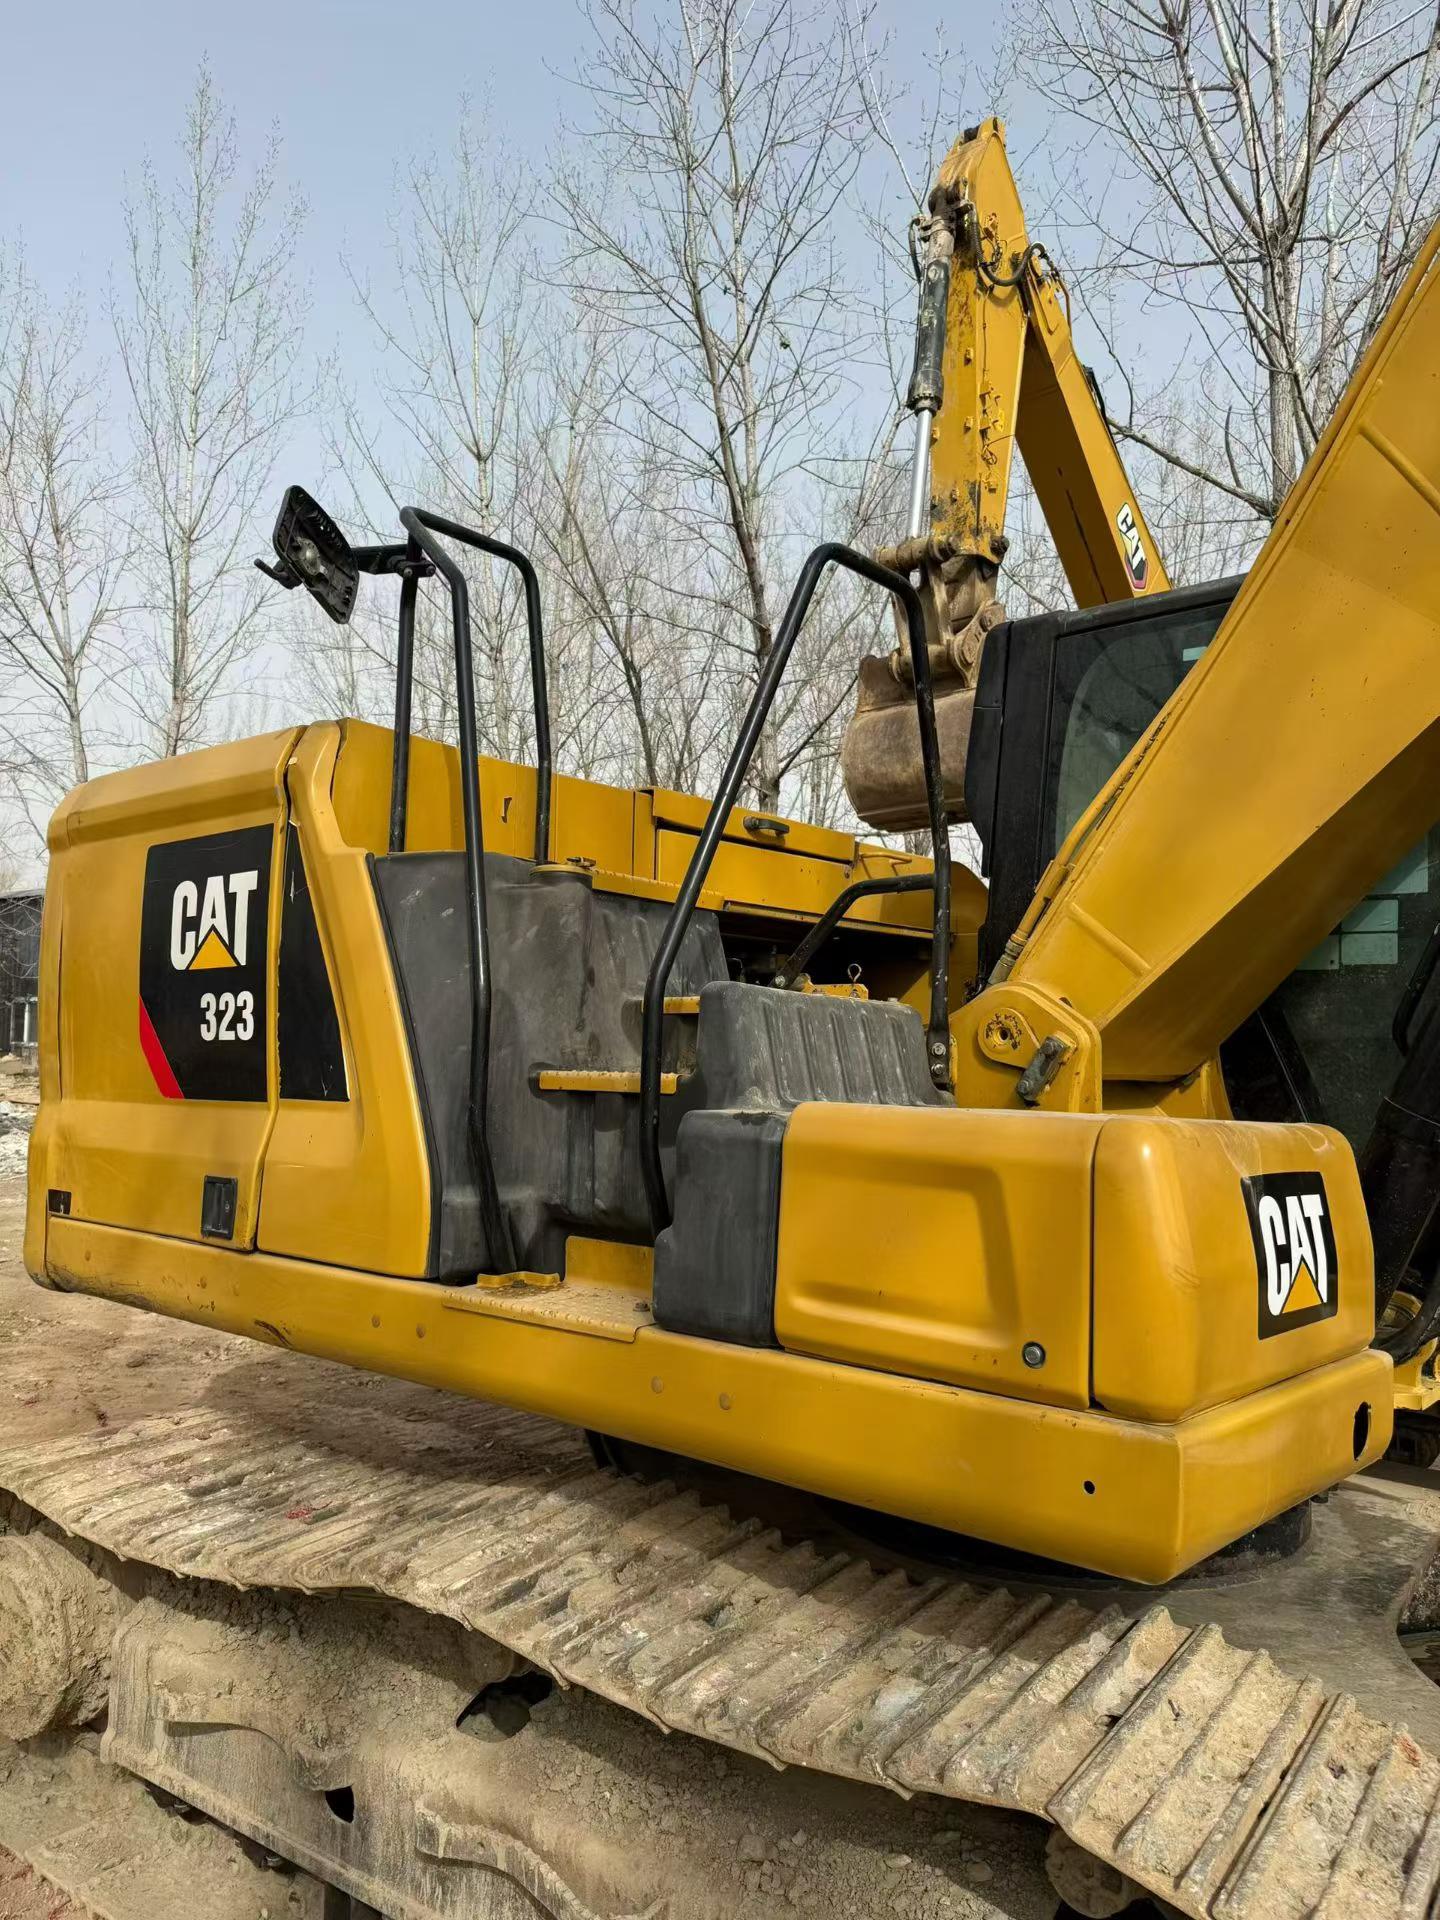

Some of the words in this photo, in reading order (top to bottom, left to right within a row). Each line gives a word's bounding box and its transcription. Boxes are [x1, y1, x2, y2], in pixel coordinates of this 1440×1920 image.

[1117, 502, 1146, 570] CAT
[171, 870, 258, 970] CAT
[200, 990, 254, 1041] 323
[1258, 1194, 1327, 1315] CAT
